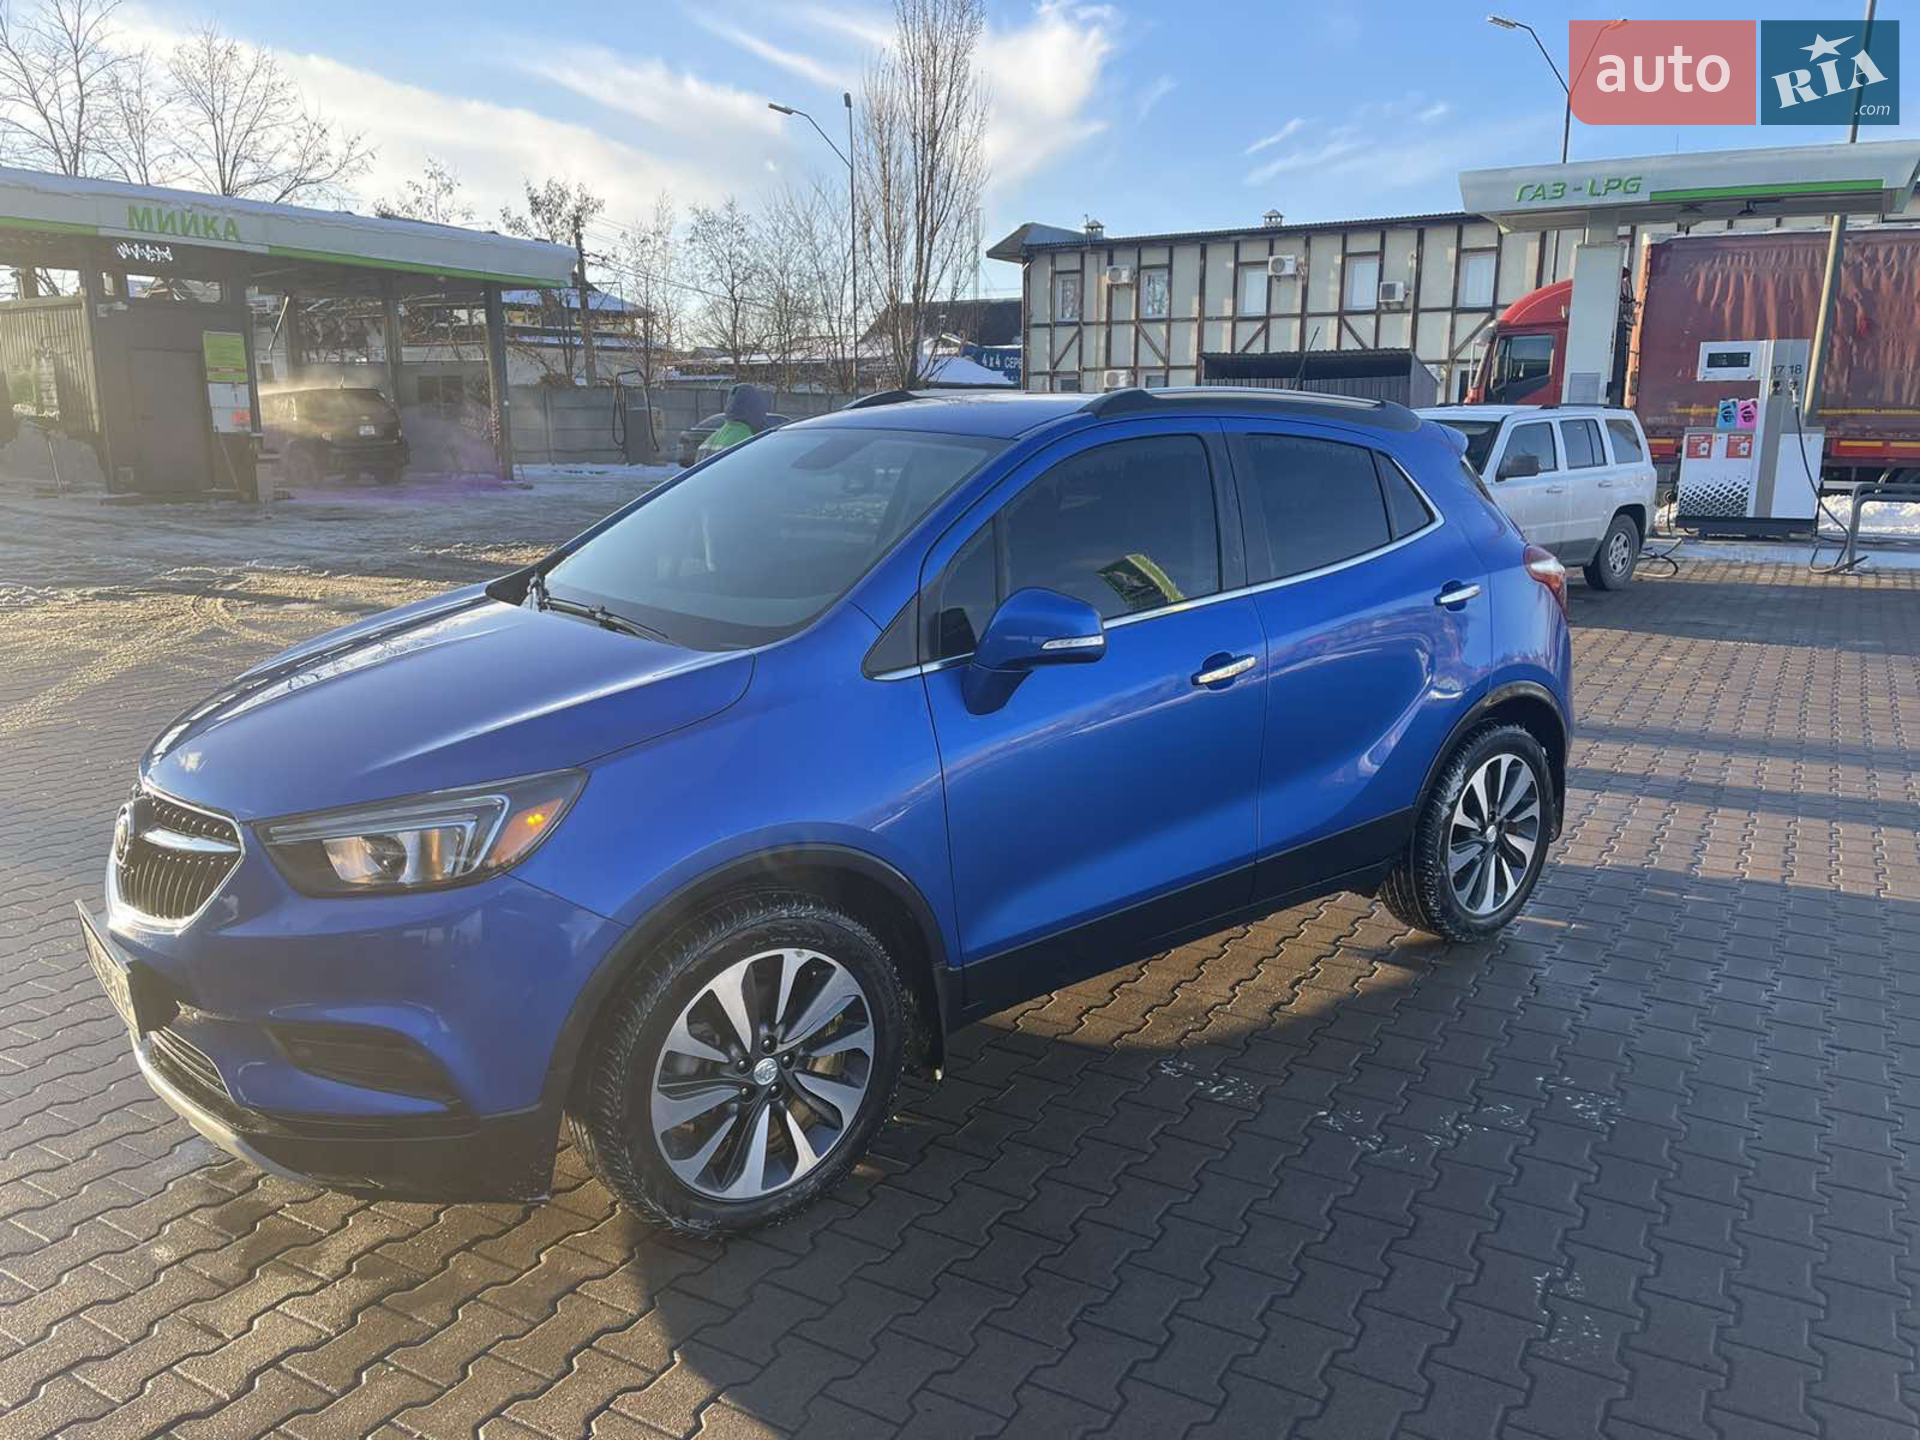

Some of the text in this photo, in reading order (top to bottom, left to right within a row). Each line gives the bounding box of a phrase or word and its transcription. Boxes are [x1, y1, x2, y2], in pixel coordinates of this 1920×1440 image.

[1517, 182, 1567, 202] ГАЗ
[1588, 176, 1642, 197] LPG
[127, 204, 240, 241] МИЙКА
[1772, 364, 1802, 375] 17 18
